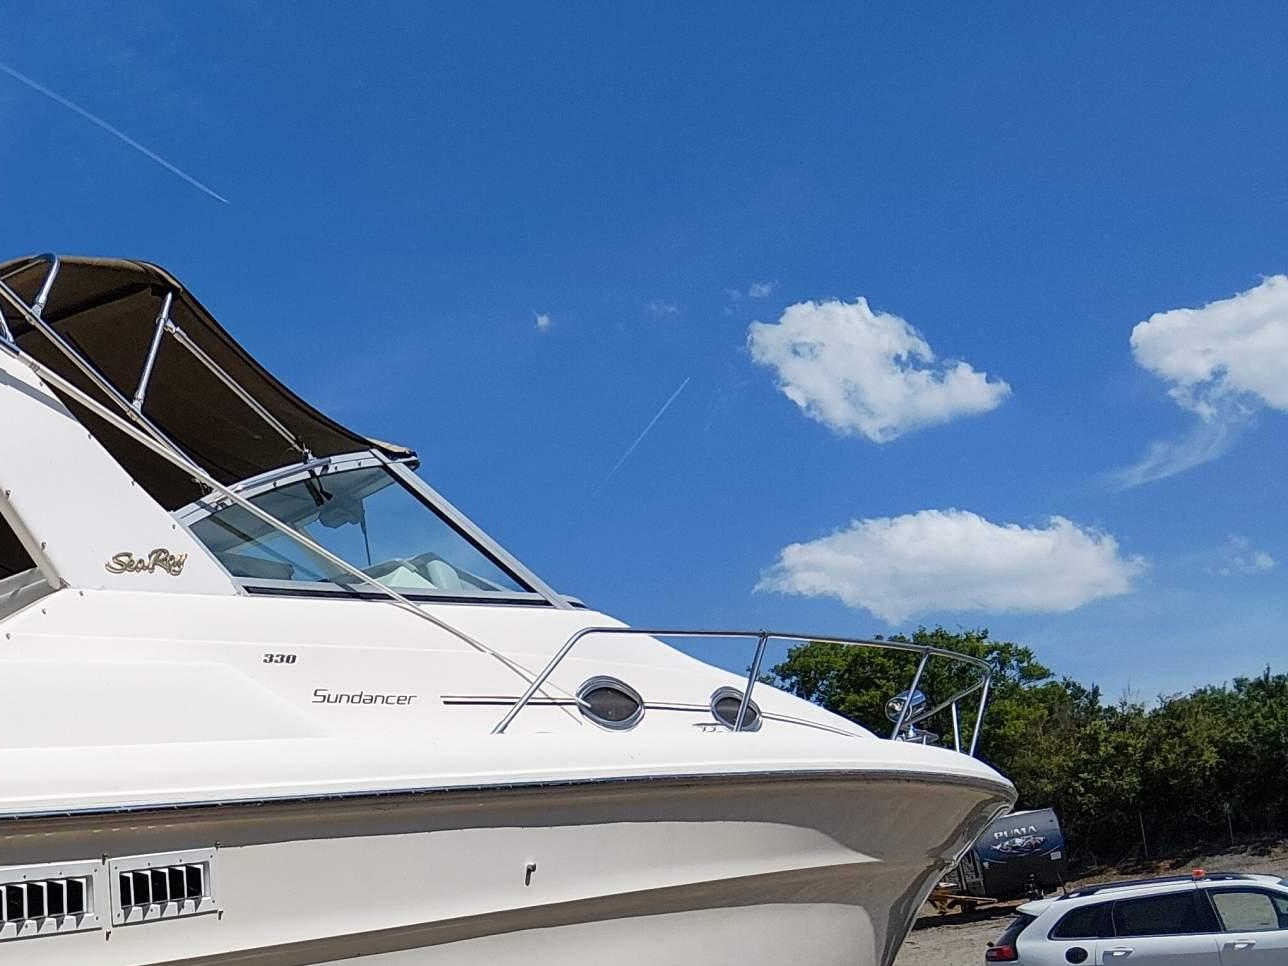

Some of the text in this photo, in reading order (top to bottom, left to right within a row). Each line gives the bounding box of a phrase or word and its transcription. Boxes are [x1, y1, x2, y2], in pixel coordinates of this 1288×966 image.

[262, 653, 297, 664] 330
[312, 688, 417, 705] Sundancer
[994, 825, 1037, 840] PUMA
